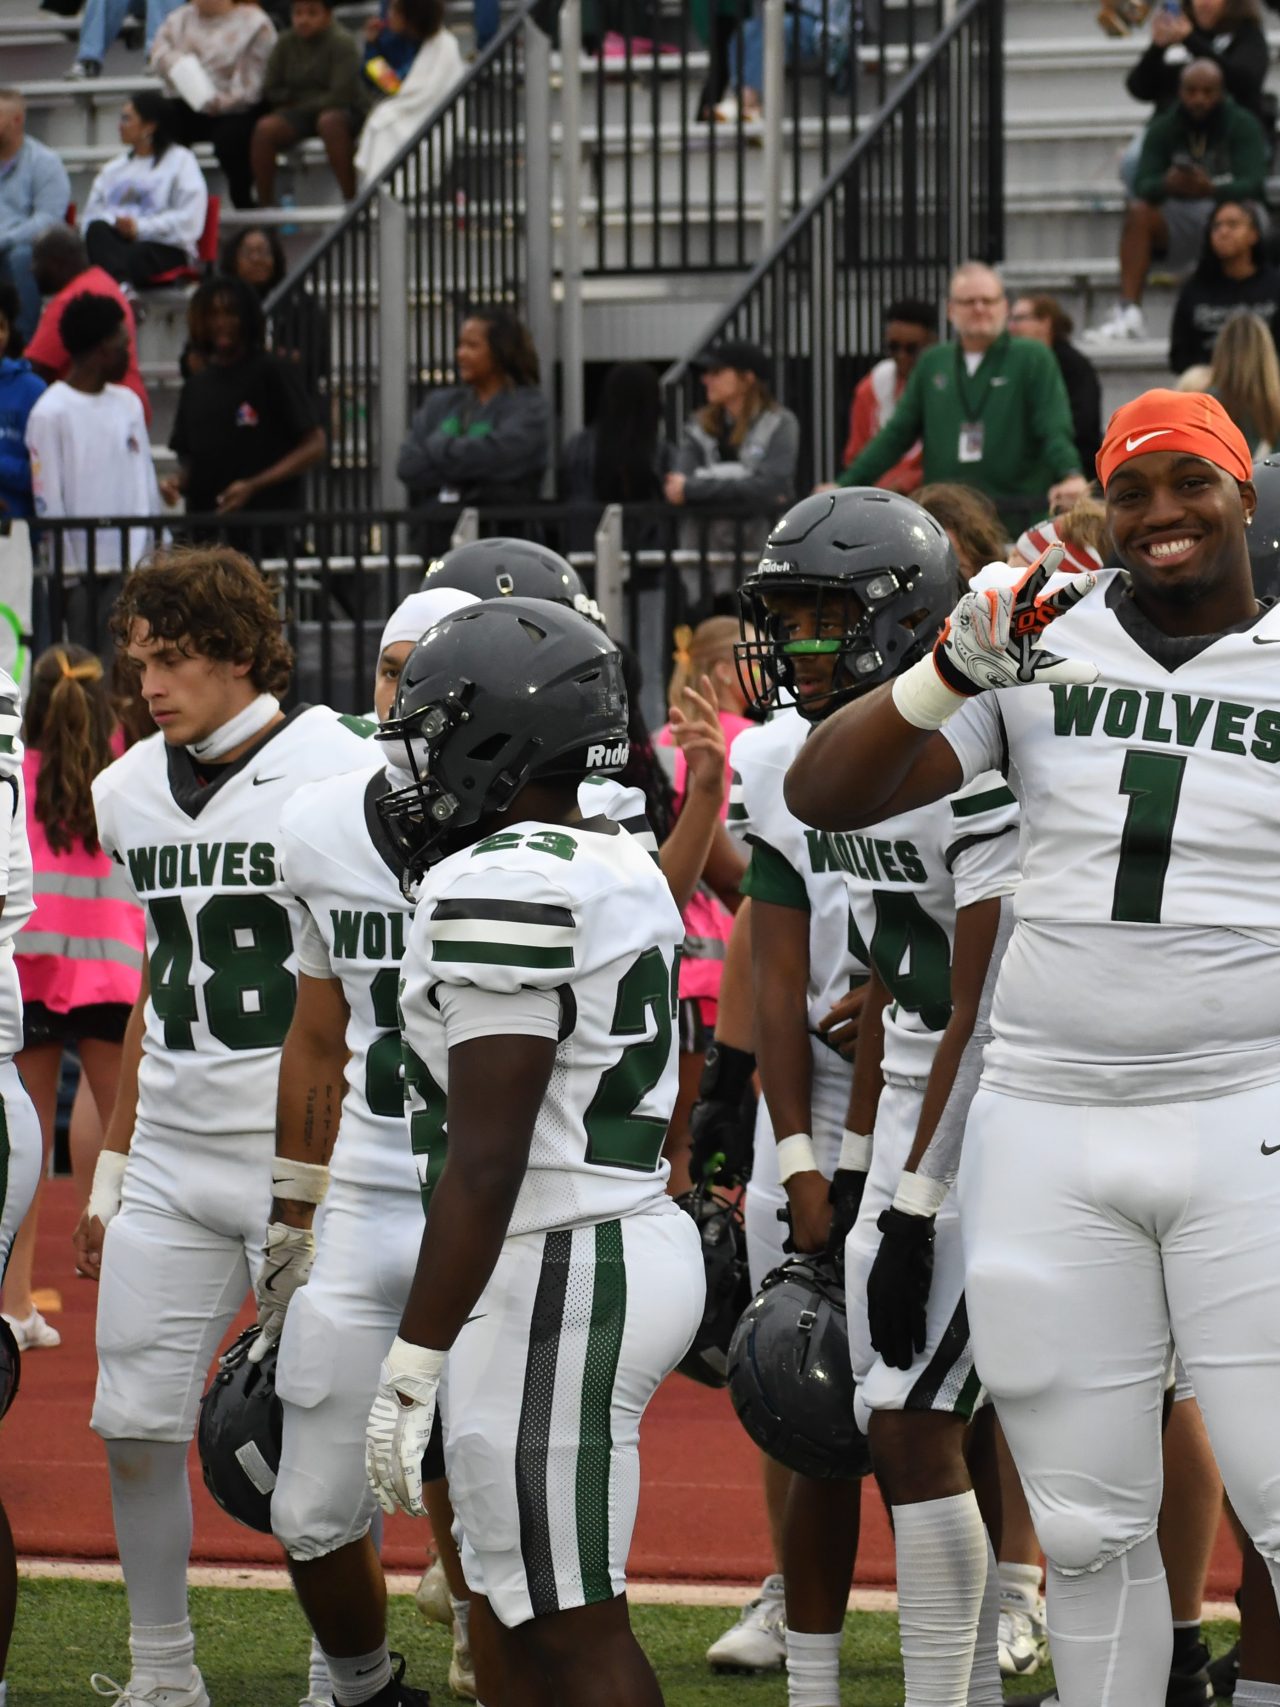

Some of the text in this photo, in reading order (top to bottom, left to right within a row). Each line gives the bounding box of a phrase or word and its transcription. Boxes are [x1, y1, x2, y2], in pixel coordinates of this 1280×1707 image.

[471, 832, 578, 861] 23
[804, 829, 928, 883] WOLVES
[1111, 749, 1188, 924] 1
[127, 842, 276, 892] WOLVES
[330, 909, 415, 960] WOL
[148, 894, 297, 1050] 48
[584, 944, 683, 1173] 2
